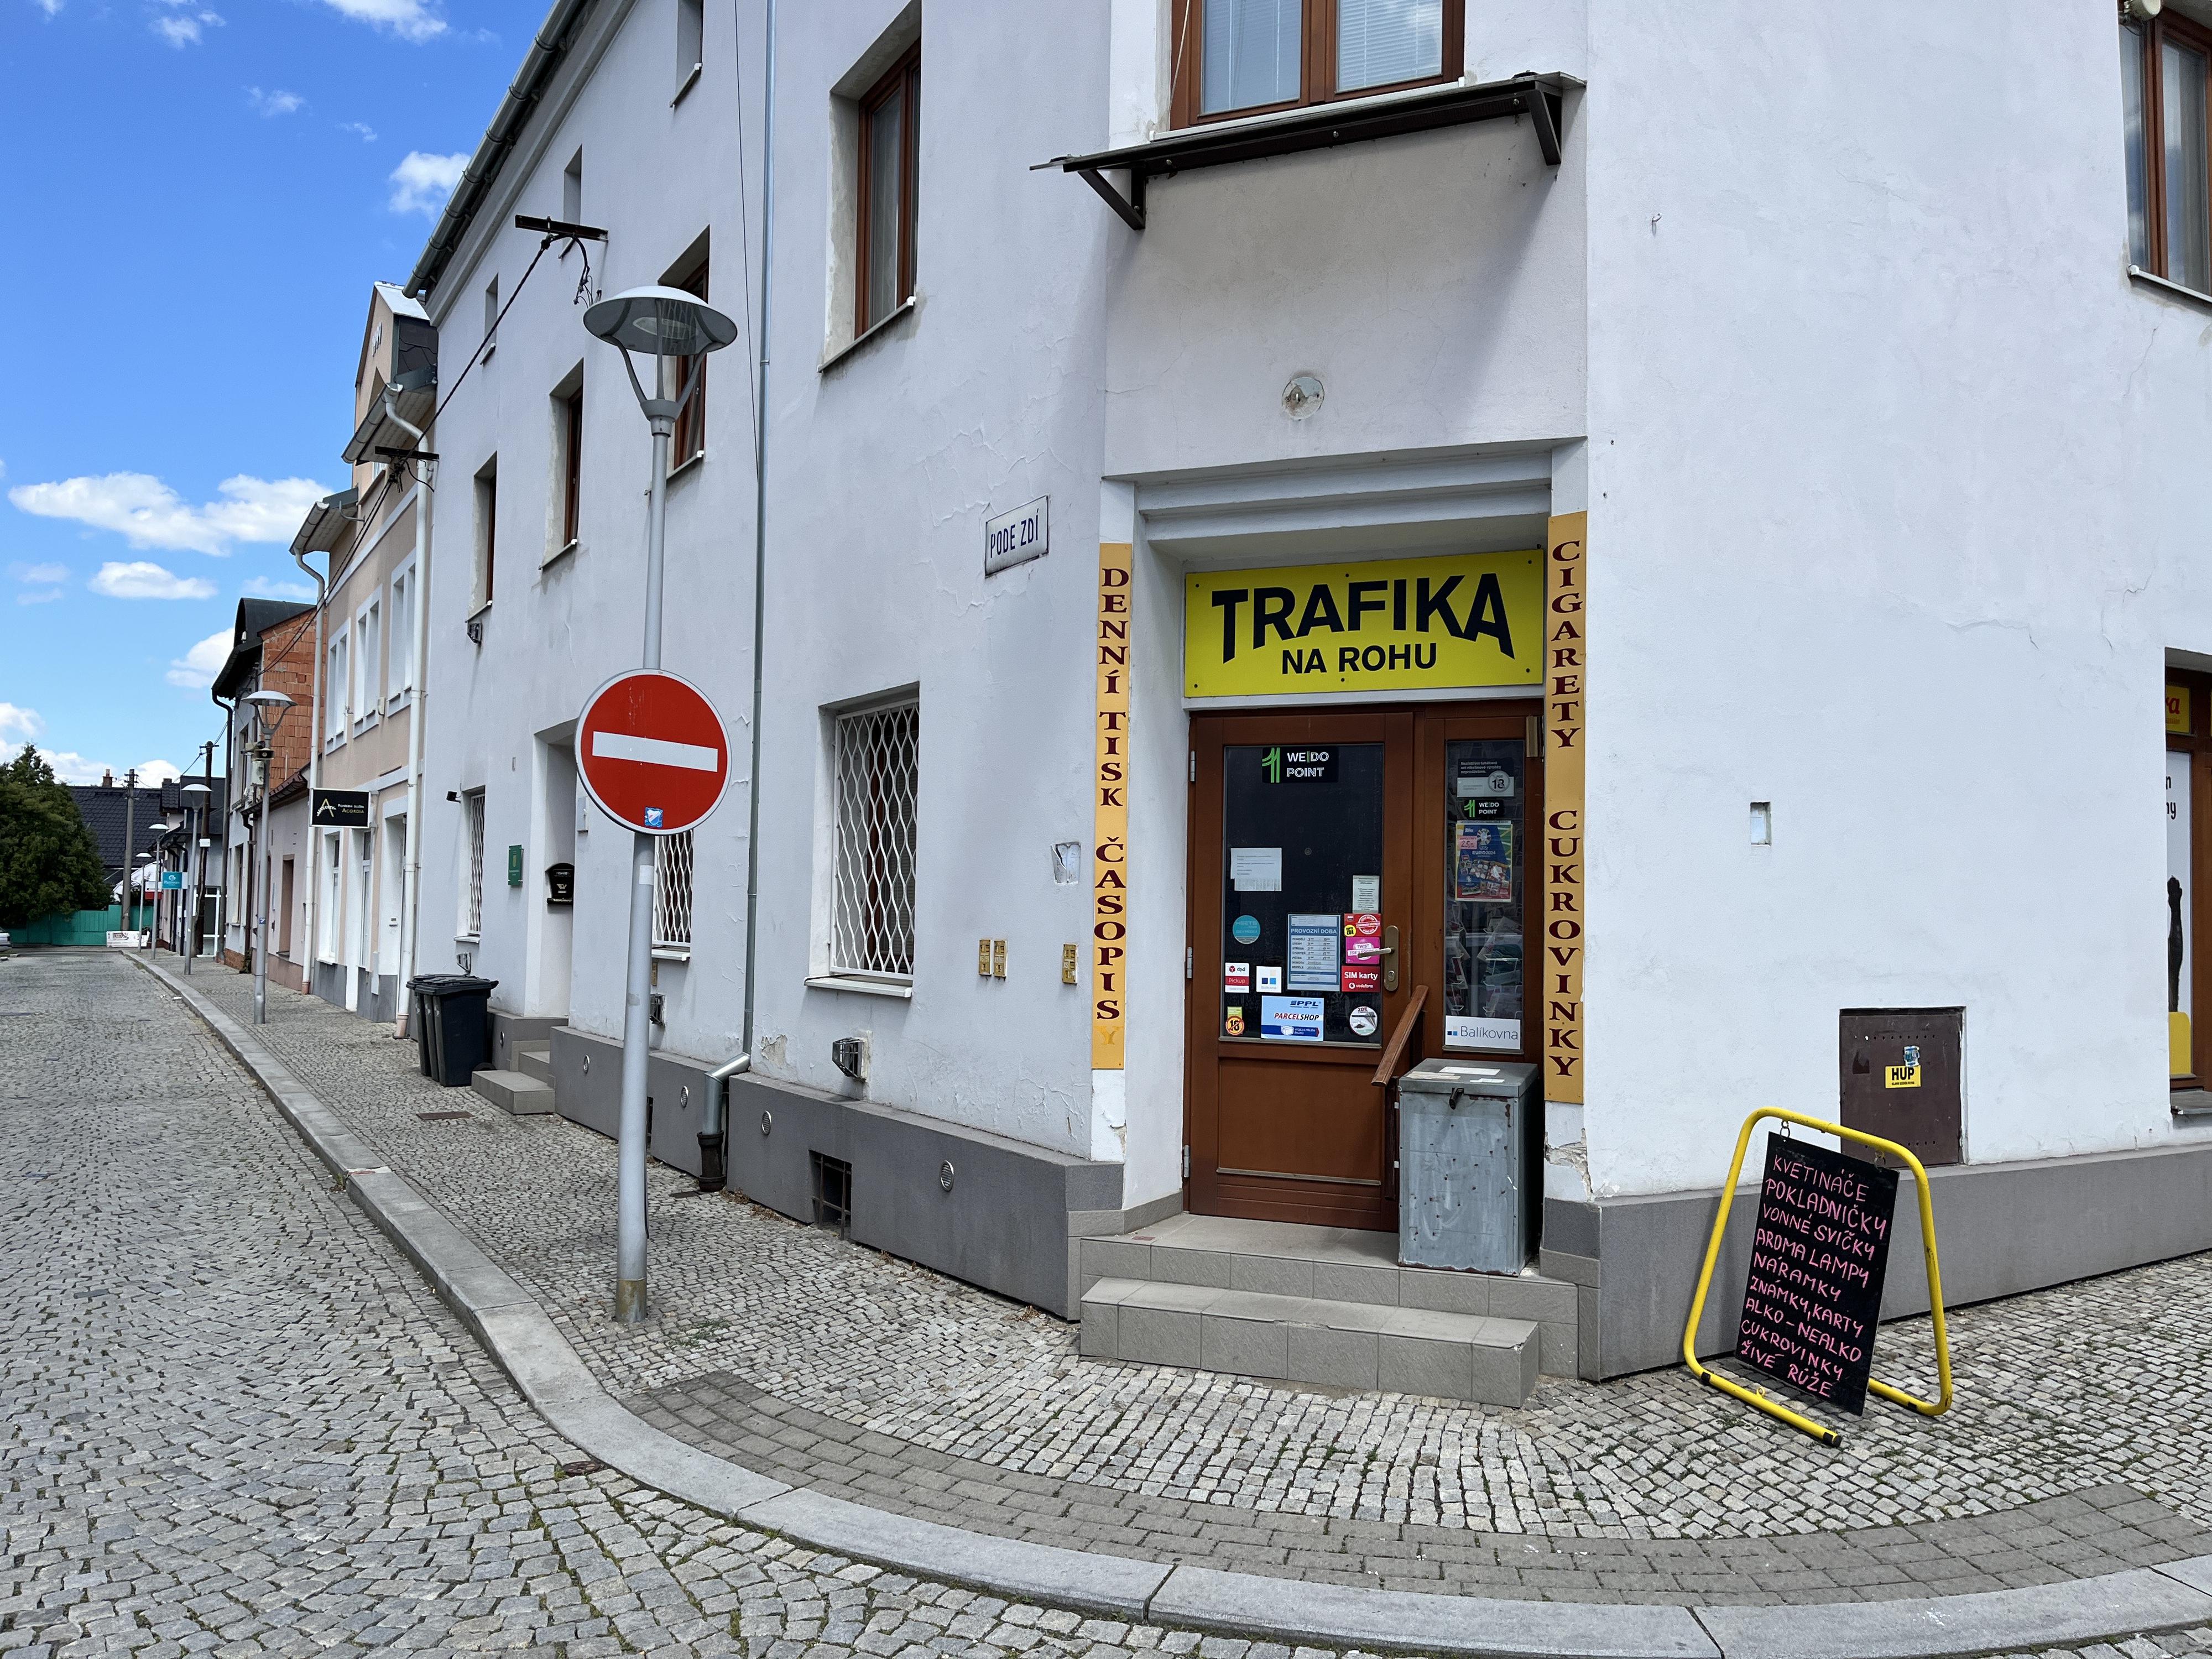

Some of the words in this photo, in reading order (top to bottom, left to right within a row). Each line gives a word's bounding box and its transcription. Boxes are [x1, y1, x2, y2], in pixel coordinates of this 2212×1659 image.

[990, 524, 1016, 559] PODE
[1020, 508, 1039, 546] ZDÍ
[1099, 568, 1129, 695] DENNÍ
[1211, 573, 1515, 664] TRAFIKA
[1551, 540, 1583, 748] CIGARETY
[1282, 648, 1327, 675] NA
[1339, 643, 1437, 672] ROHU
[1099, 711, 1126, 806] TISK
[1286, 767, 1324, 778] POINT
[1359, 972, 1378, 980] karty
[1274, 1013, 1319, 1021] PARCELSHOP
[1460, 1026, 1519, 1041] Balíkovna
[1891, 1067, 1915, 1081] HUP
[1772, 1154, 1870, 1202] KVETINÁČE
[1763, 1203, 1812, 1235] VONNÉ
[1765, 1178, 1887, 1240] POKLADNIČKY
[1754, 1251, 1841, 1302] NÁRAMKY
[1755, 1228, 1806, 1261] AROMA
[1808, 1248, 1869, 1288] LAMPY
[1741, 1319, 1843, 1381] CUKROVINKY
[1798, 1322, 1862, 1363] NEALKO
[1741, 1339, 1785, 1369] ŽIVÉ
[1787, 1363, 1833, 1398] RŮŽE
